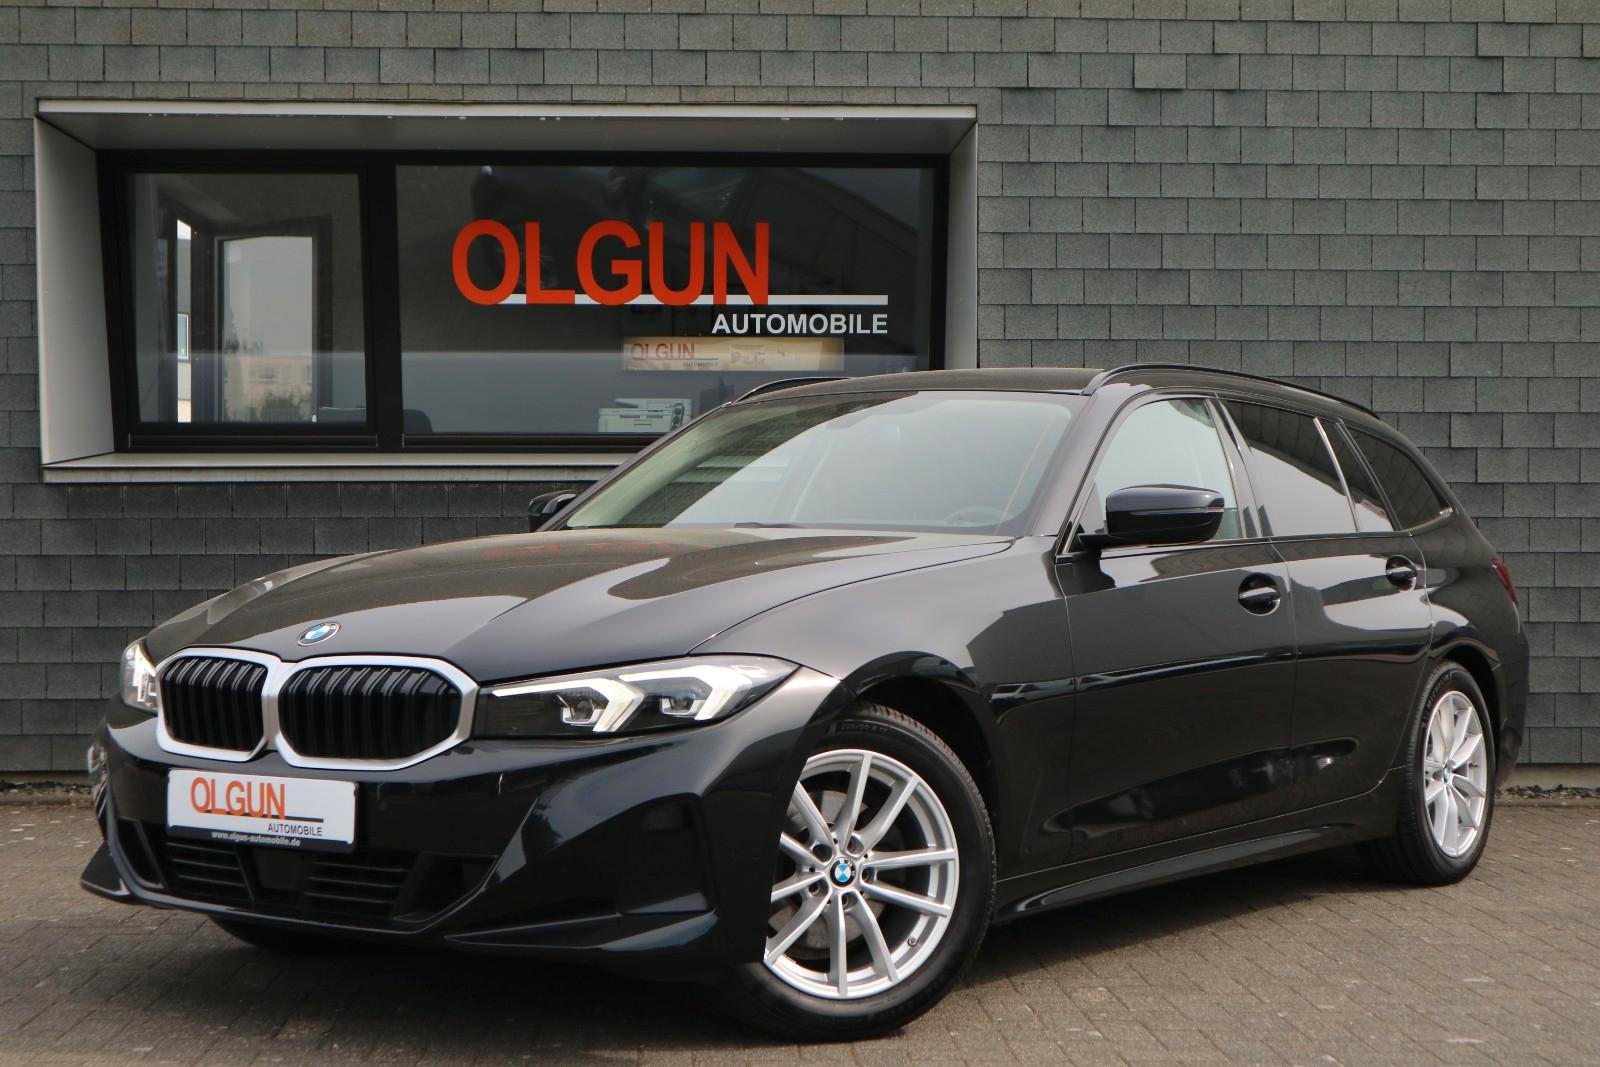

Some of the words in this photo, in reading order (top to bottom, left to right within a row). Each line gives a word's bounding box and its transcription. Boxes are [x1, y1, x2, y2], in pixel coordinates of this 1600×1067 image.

[452, 219, 770, 306] OLGUN
[712, 314, 888, 335] AUTOMOBILE
[632, 343, 695, 361] OLGUN
[191, 777, 286, 820] OLGUN
[211, 831, 301, 847] www.olgun-automobile.de
[267, 823, 323, 837] AUTOMOBILE
